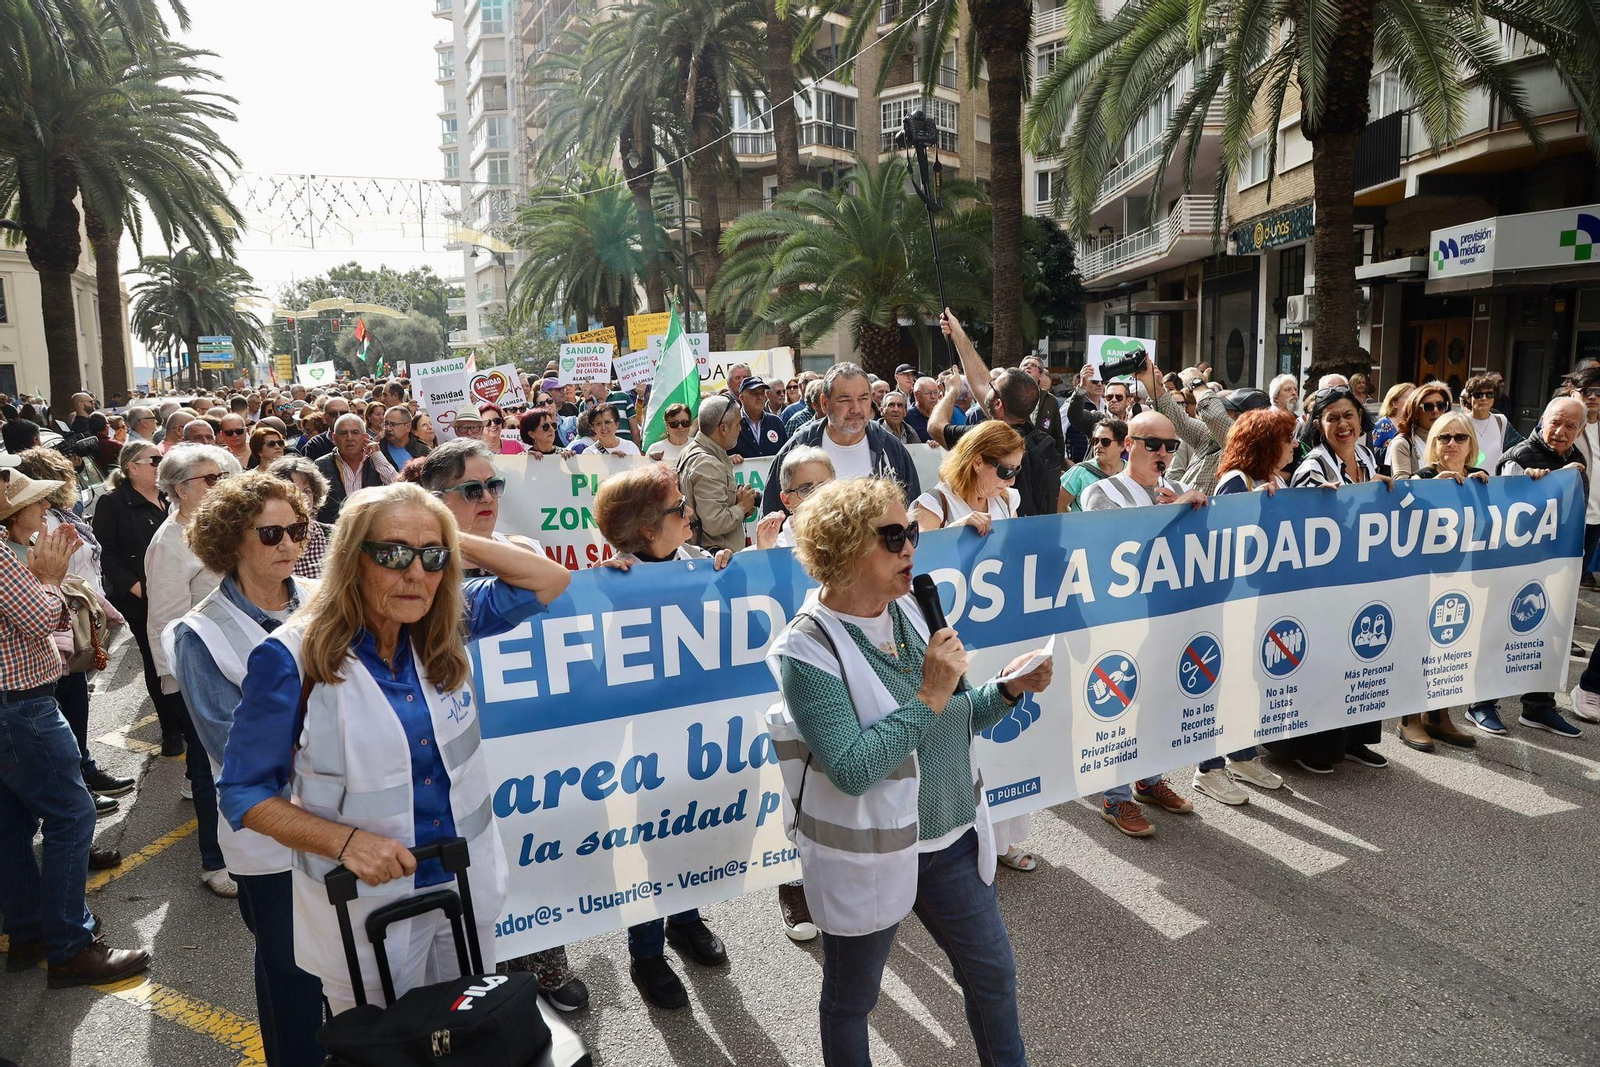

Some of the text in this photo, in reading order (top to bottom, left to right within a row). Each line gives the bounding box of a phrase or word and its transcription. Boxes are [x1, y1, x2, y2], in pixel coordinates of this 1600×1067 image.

[1460, 227, 1491, 246] previsión
[1460, 243, 1486, 257] médica
[1459, 257, 1475, 265] seguros
[566, 346, 605, 355] SANIDAD
[417, 362, 464, 376] LA SANIDAD
[623, 358, 638, 366] SALUD
[634, 360, 650, 368] DEREC
[630, 370, 638, 378] SE
[476, 377, 502, 390] SANIDAD
[430, 390, 464, 401] Sanidad
[500, 398, 524, 408] ALAMEDA
[541, 506, 600, 531] ZON
[1023, 548, 1096, 614] LA
[1108, 515, 1342, 602] SANIDAD
[1357, 494, 1558, 563] PÚBLICA
[1504, 639, 1544, 651] Asistencia
[1422, 649, 1472, 666] Más y Mejores
[1506, 650, 1542, 662] Sanitaria
[1344, 662, 1394, 680] Más Personal
[1422, 662, 1469, 677] Instalaciones
[1505, 661, 1542, 674] Universal
[1350, 677, 1386, 693] y Mejores
[1426, 673, 1464, 690] y Servicios
[1266, 684, 1298, 698] No a las
[1344, 688, 1390, 704] Condiciones
[1426, 685, 1464, 700] Sanitarios
[1182, 708, 1194, 718] No
[1203, 703, 1214, 714] los
[1270, 697, 1294, 710] Listas
[1346, 700, 1386, 716] de Trabajo
[1181, 717, 1216, 732] Recortes
[1261, 710, 1299, 726] de espera
[1096, 726, 1126, 742] No a la
[1172, 725, 1224, 748] en la Sanidad
[1254, 720, 1308, 738] Interminables
[1081, 736, 1138, 760] Privatización
[492, 715, 780, 819] area bla
[1080, 748, 1138, 774] de la Sanidad
[998, 781, 1038, 801] PÚBLICA
[518, 833, 564, 867] la
[576, 788, 748, 857] sanidad
[495, 906, 563, 938] ador@s
[578, 881, 663, 915] Usuari@s
[677, 859, 748, 890] Vecin@s
[450, 975, 509, 1011] FILA
